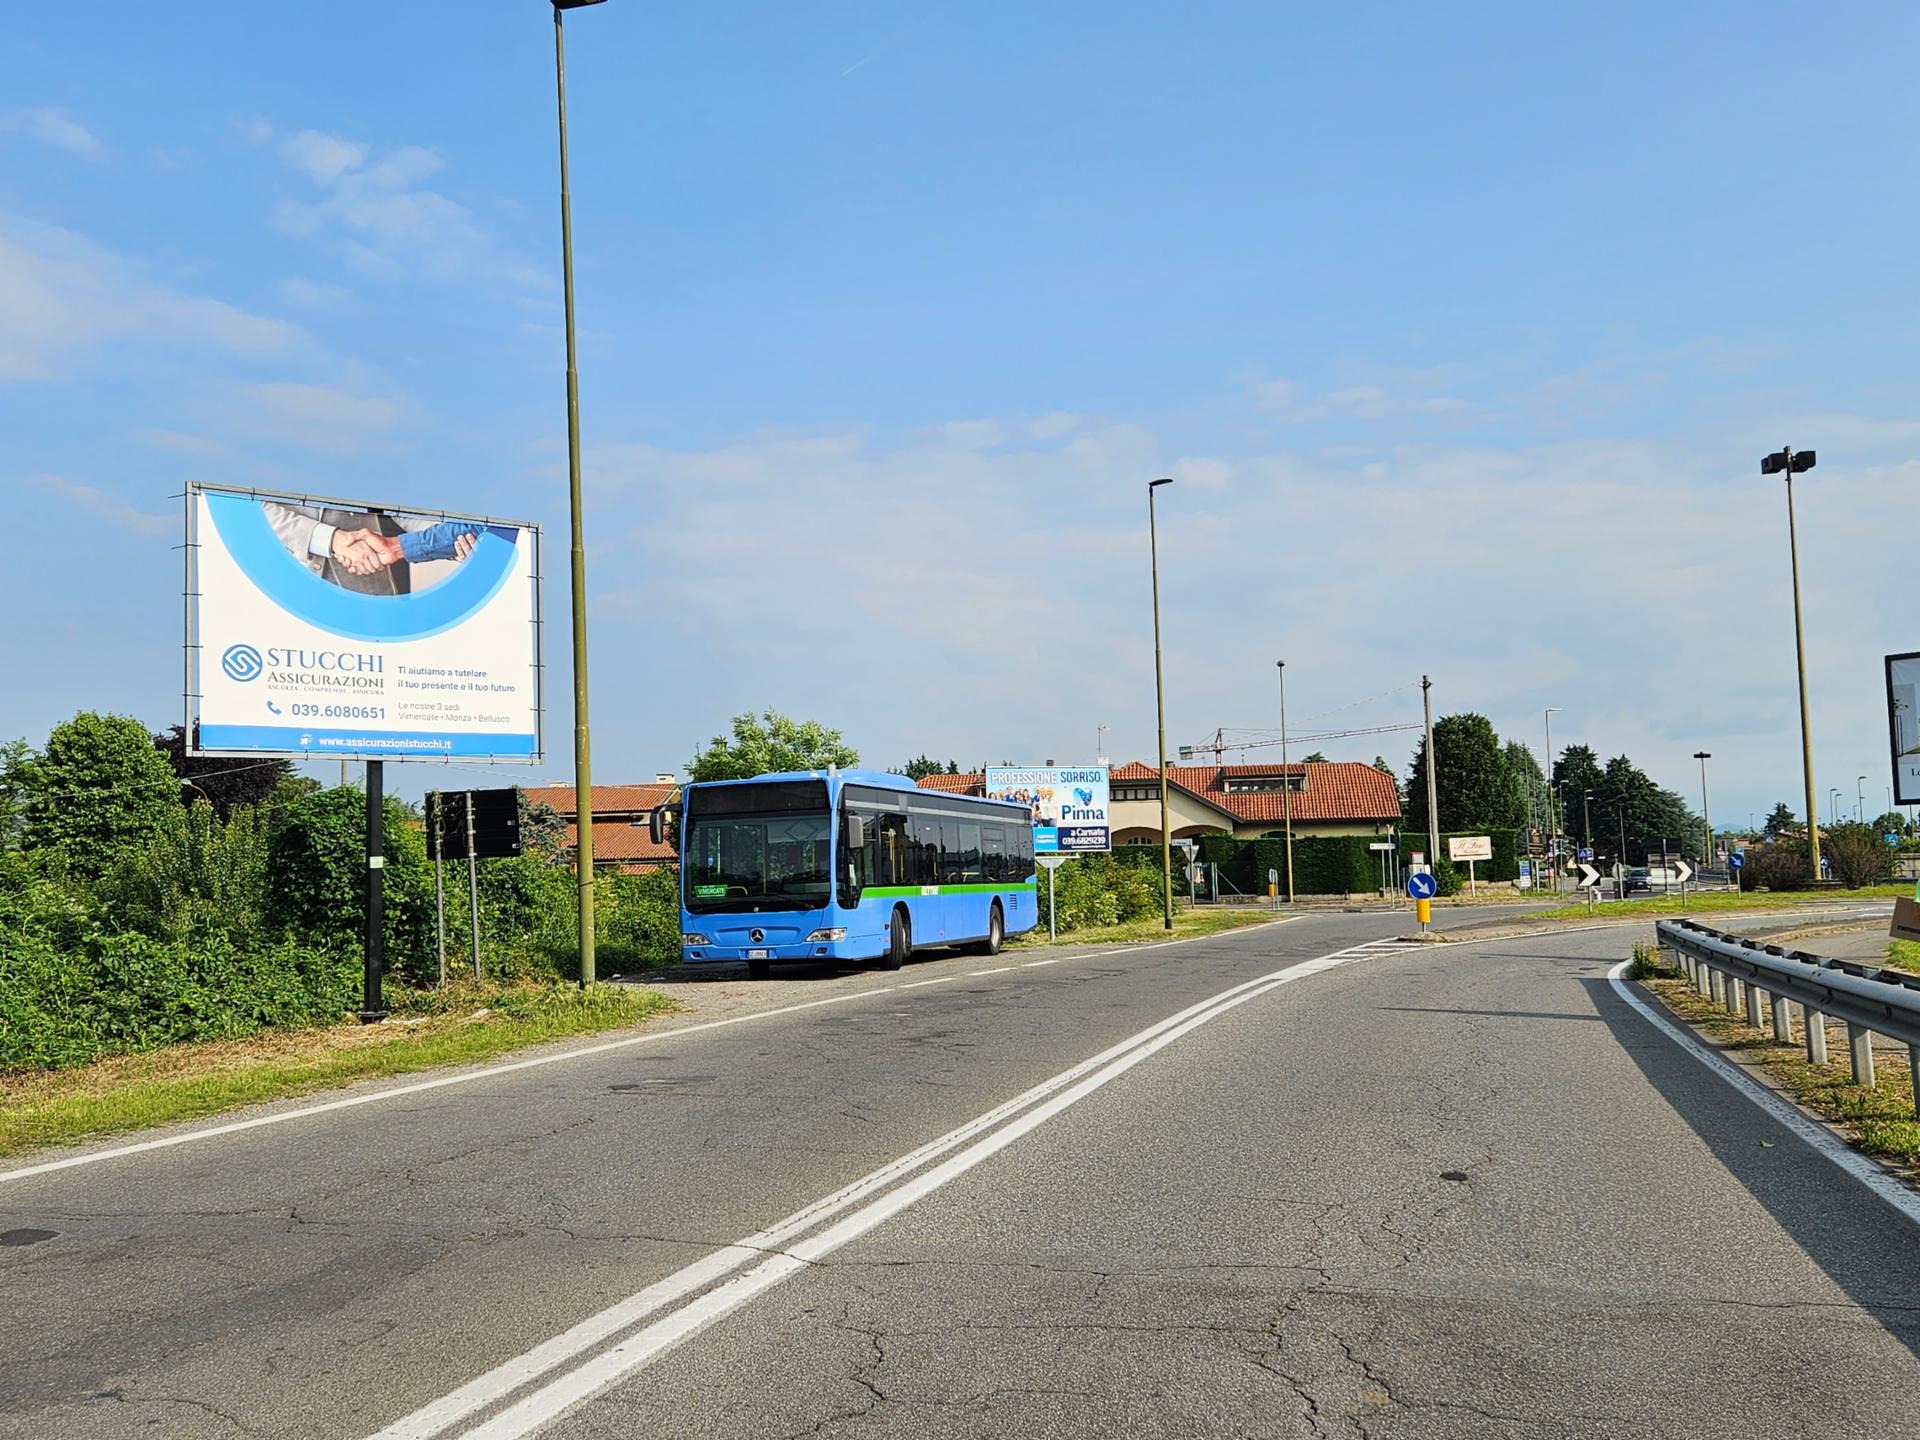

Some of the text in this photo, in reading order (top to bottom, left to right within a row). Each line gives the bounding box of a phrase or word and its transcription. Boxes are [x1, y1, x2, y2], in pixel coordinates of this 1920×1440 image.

[267, 648, 384, 673] STUCCHI
[398, 666, 488, 678] Ti aiutiamo a tutelare
[267, 671, 384, 689] ASSICURAZIONI
[397, 680, 404, 688] il
[405, 681, 420, 689] tuo
[421, 682, 459, 692] presente
[460, 683, 466, 691] e
[475, 684, 489, 692] tuo
[490, 683, 516, 693] futuro
[291, 703, 385, 719] 039.6080651
[398, 702, 408, 710] Le
[410, 703, 435, 711] nostre
[398, 712, 511, 723] Vimercate Monza Bellusco
[319, 737, 451, 749] www.assicurazionistucchi.it
[992, 771, 1057, 784] PROFESSIONE
[1061, 804, 1105, 820] Pinna
